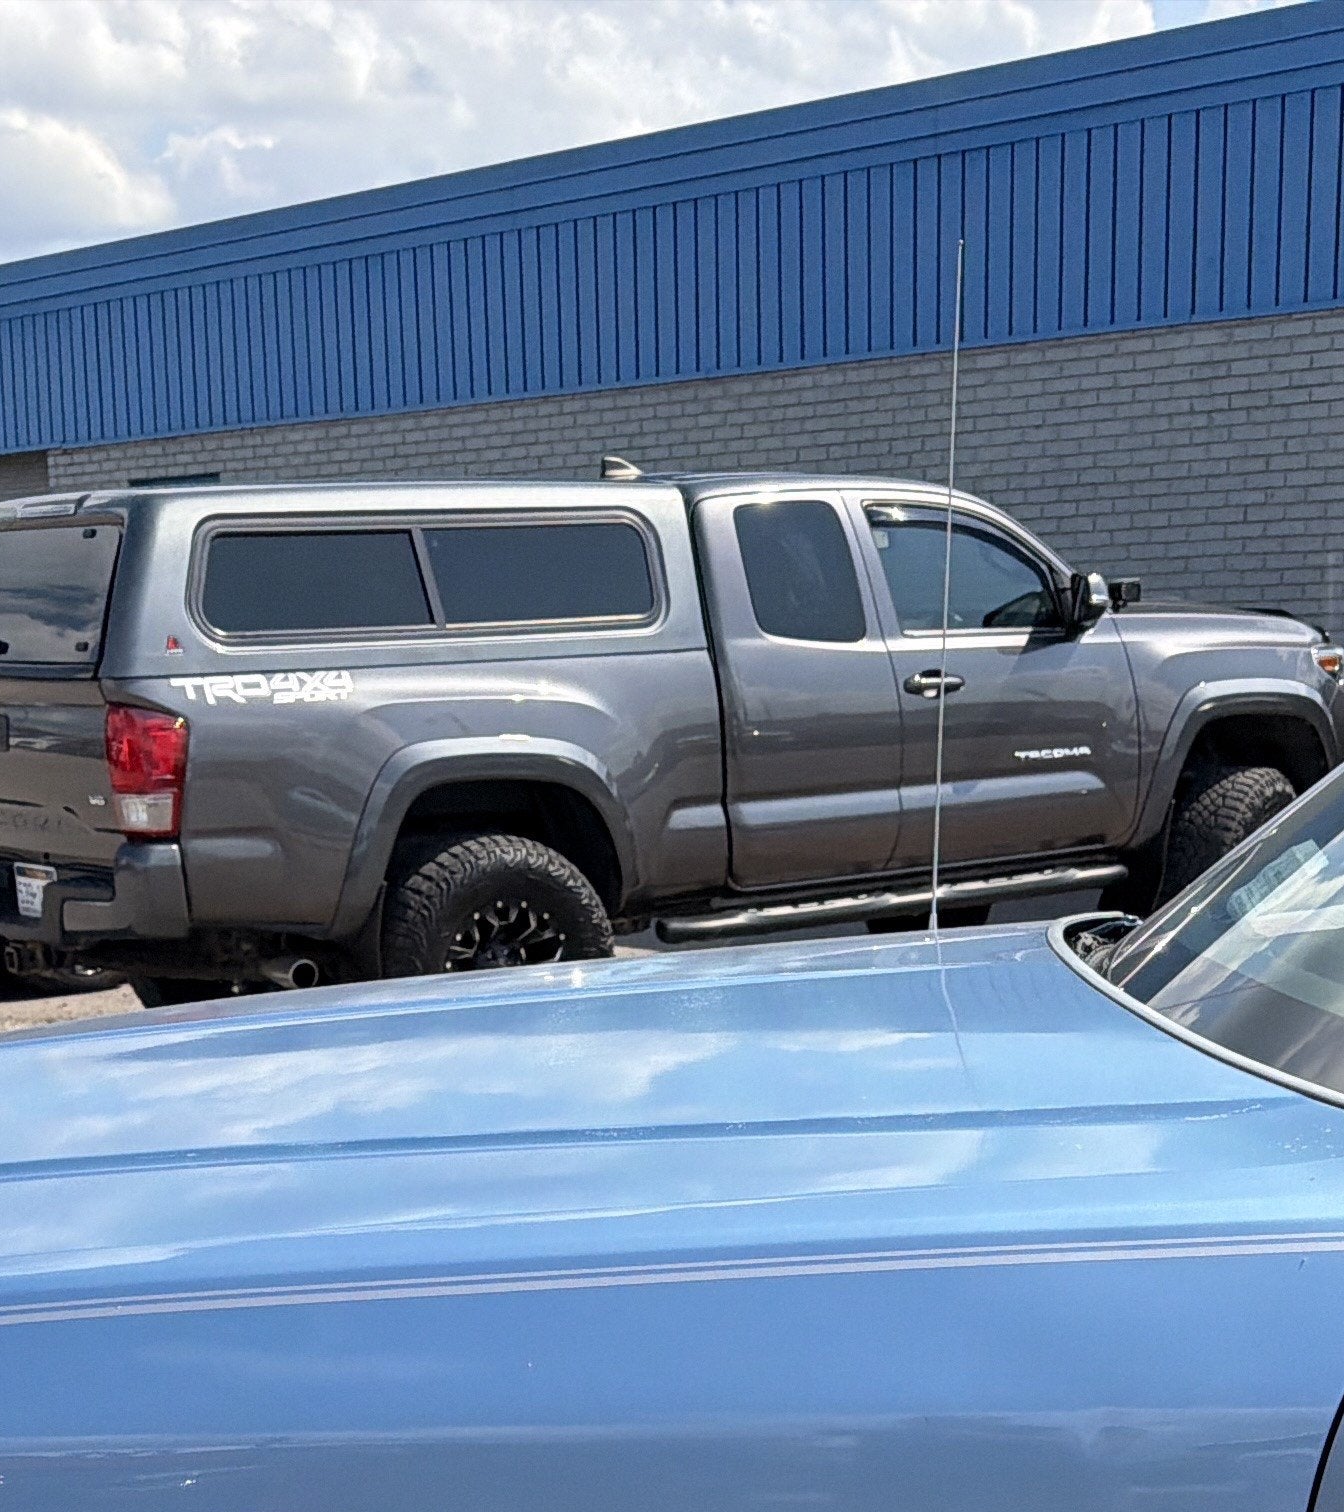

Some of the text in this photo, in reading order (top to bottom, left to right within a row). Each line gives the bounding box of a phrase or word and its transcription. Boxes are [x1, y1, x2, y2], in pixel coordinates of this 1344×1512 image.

[170, 673, 271, 704] TRD
[273, 690, 348, 704] SPORT
[1014, 746, 1091, 760] TACOMA
